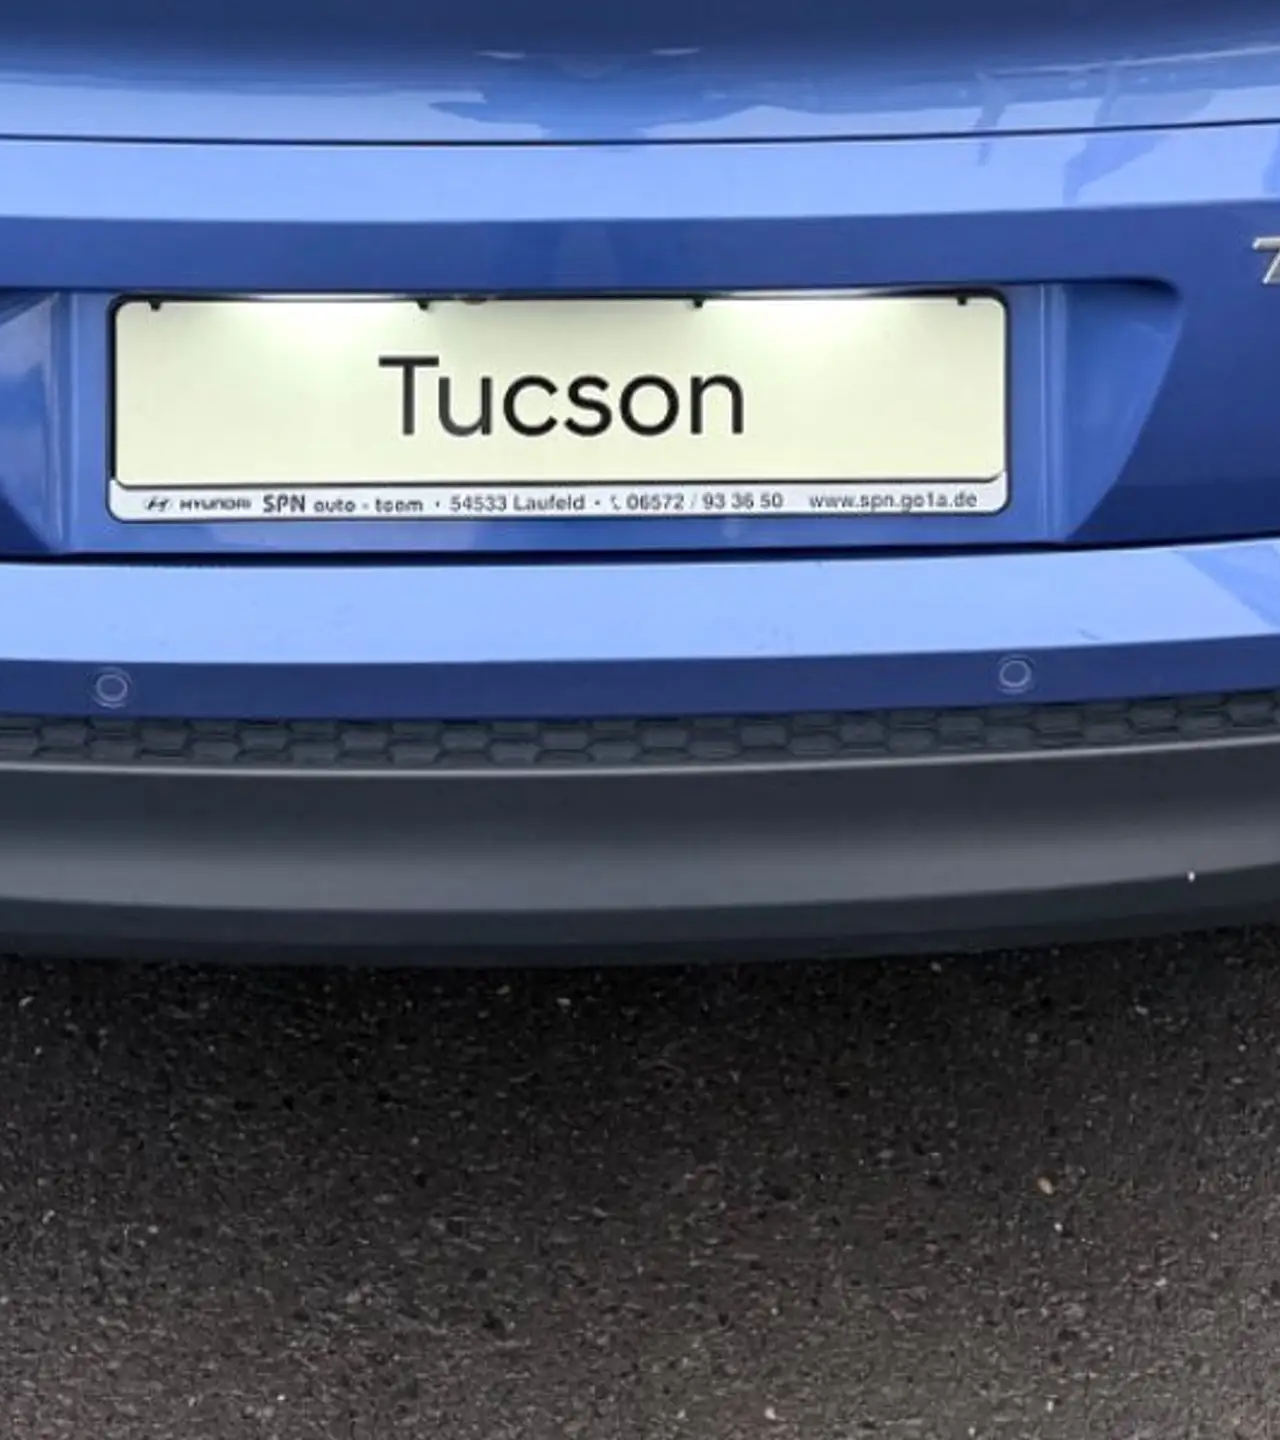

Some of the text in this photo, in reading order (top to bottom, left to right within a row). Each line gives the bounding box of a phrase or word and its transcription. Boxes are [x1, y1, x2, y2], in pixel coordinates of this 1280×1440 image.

[378, 356, 744, 437] Tucson
[263, 494, 306, 513] SPN
[313, 498, 356, 513] auto
[449, 494, 507, 512] 54533
[513, 493, 586, 511] Laufeld
[626, 492, 684, 511] 06572
[703, 491, 725, 510] 93
[760, 491, 784, 509] 50
